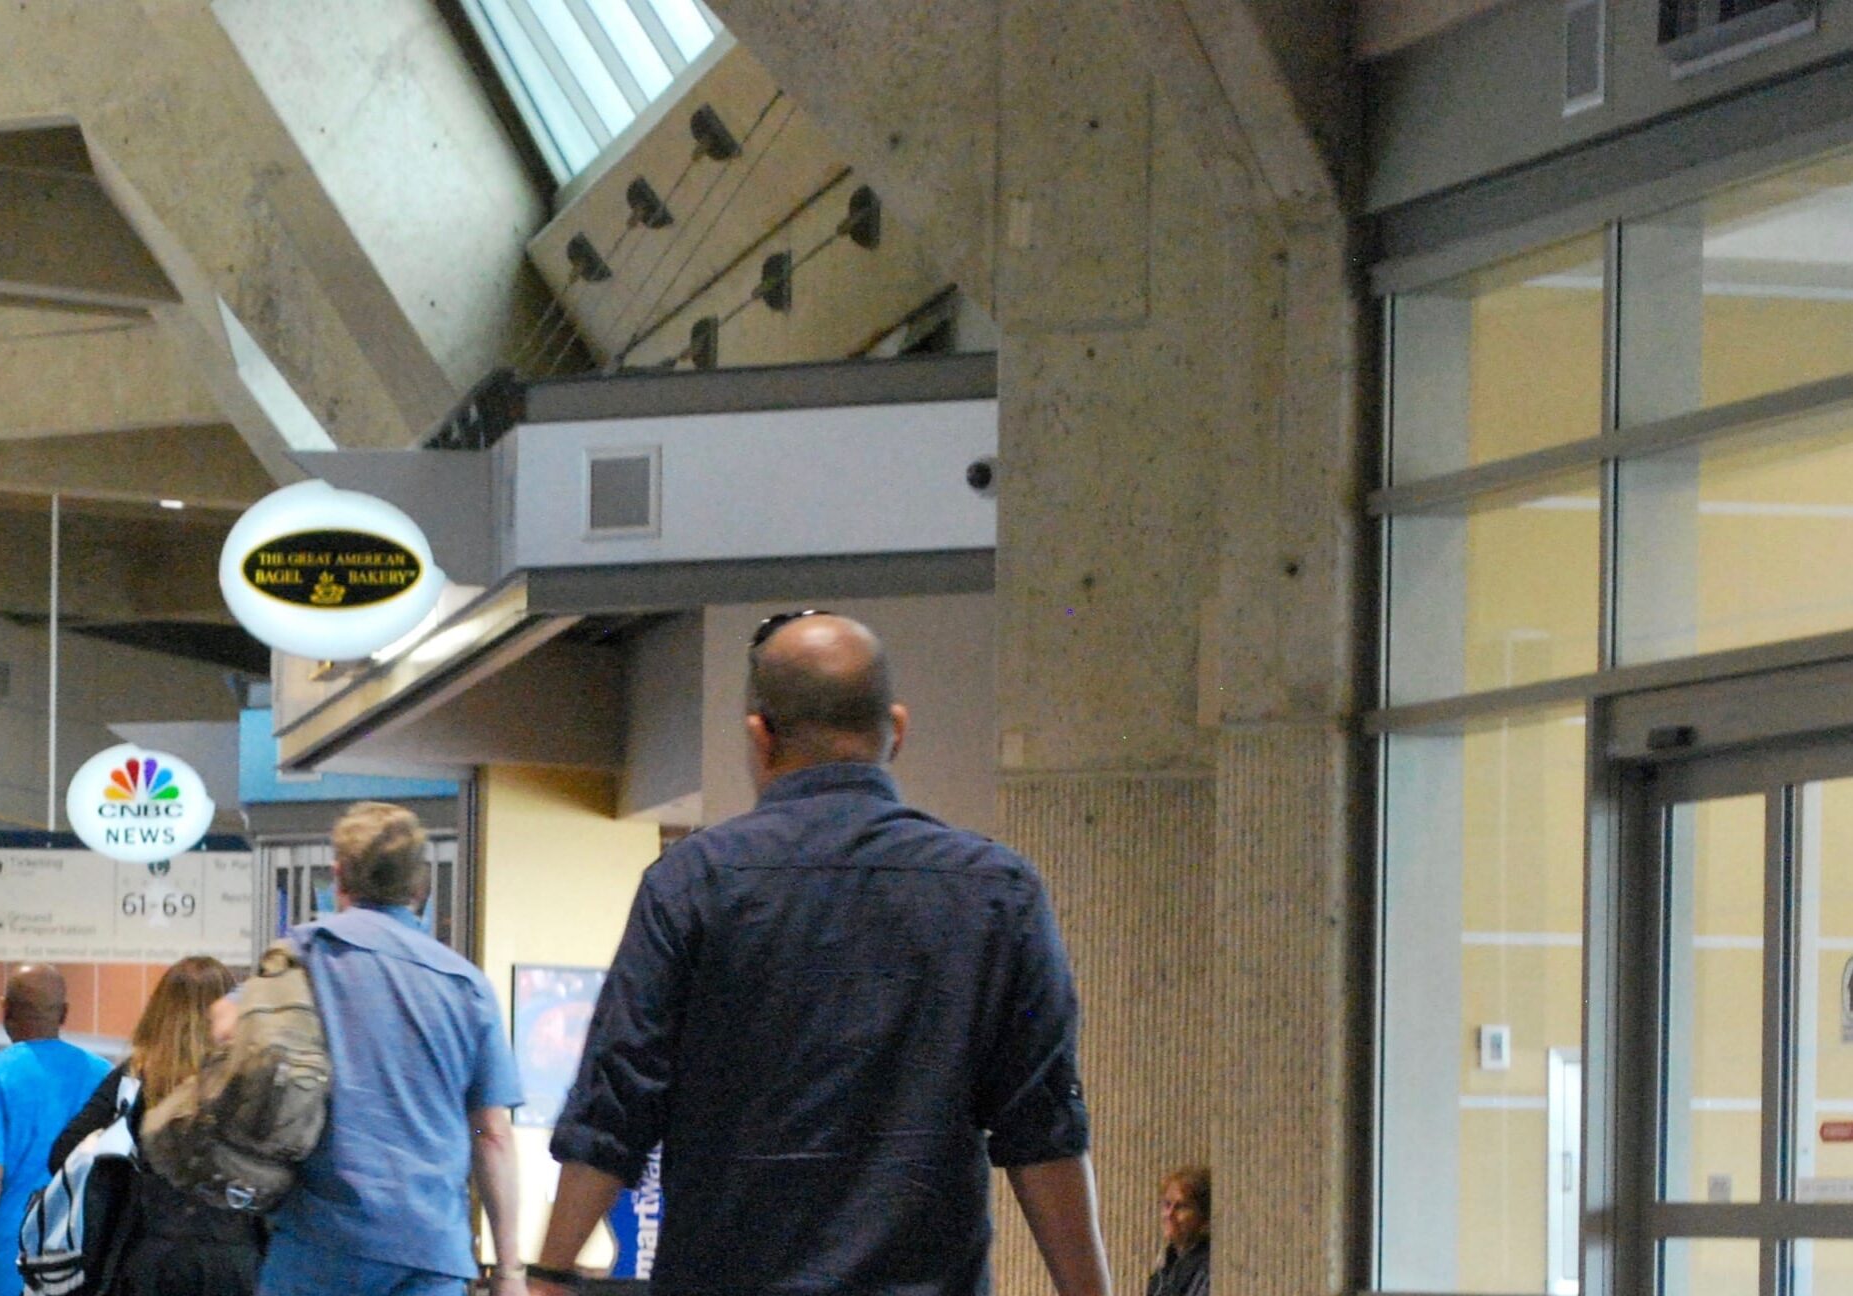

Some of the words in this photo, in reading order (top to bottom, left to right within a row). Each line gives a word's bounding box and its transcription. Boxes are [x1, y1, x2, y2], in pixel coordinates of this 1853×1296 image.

[258, 552, 283, 566] THE
[287, 552, 332, 566] GREAT
[335, 552, 405, 566] AMERICAN
[255, 569, 302, 584] BAGEL
[97, 803, 184, 818] CNBC
[106, 827, 175, 844] NEWS
